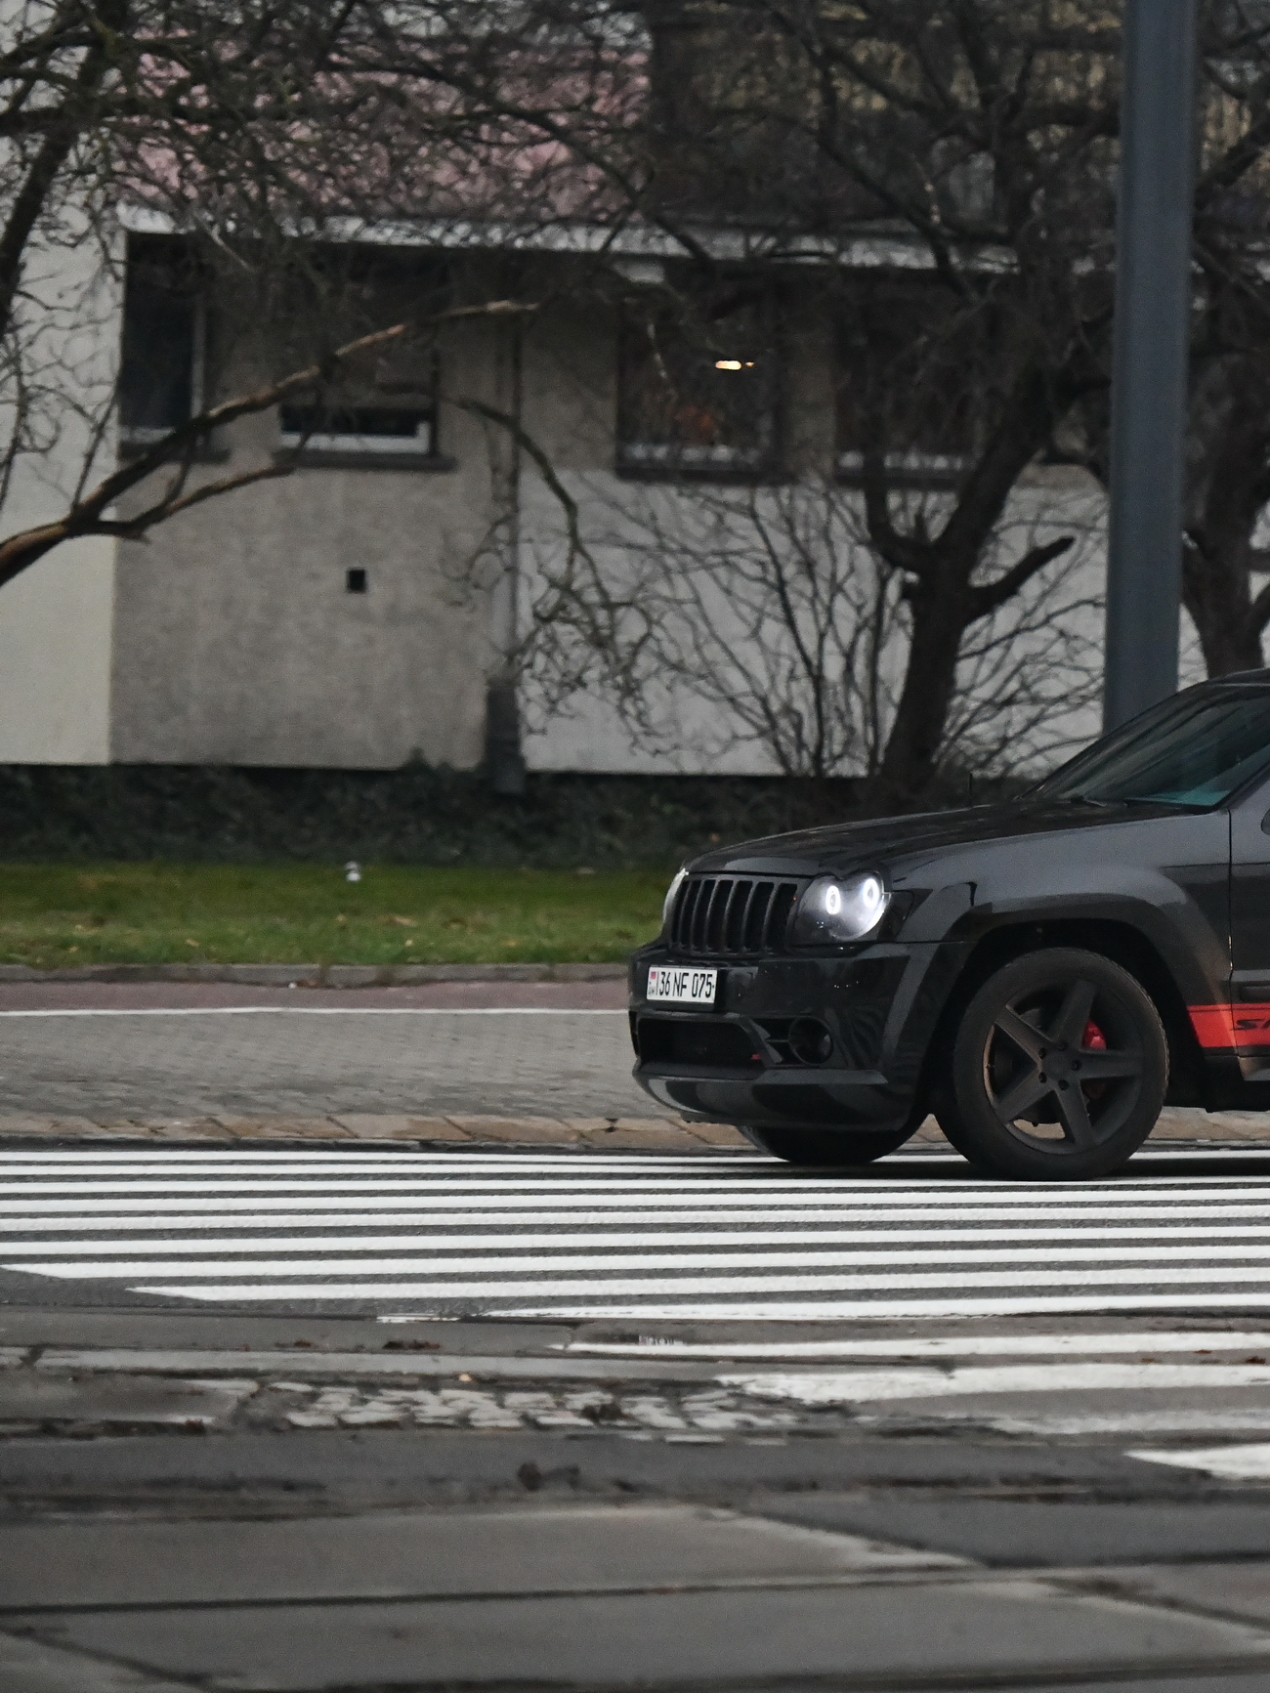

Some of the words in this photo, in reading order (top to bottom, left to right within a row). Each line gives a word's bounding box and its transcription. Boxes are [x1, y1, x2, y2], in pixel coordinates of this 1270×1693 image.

[659, 971, 671, 996] 36
[672, 972, 689, 997] NF
[691, 973, 713, 998] 075
